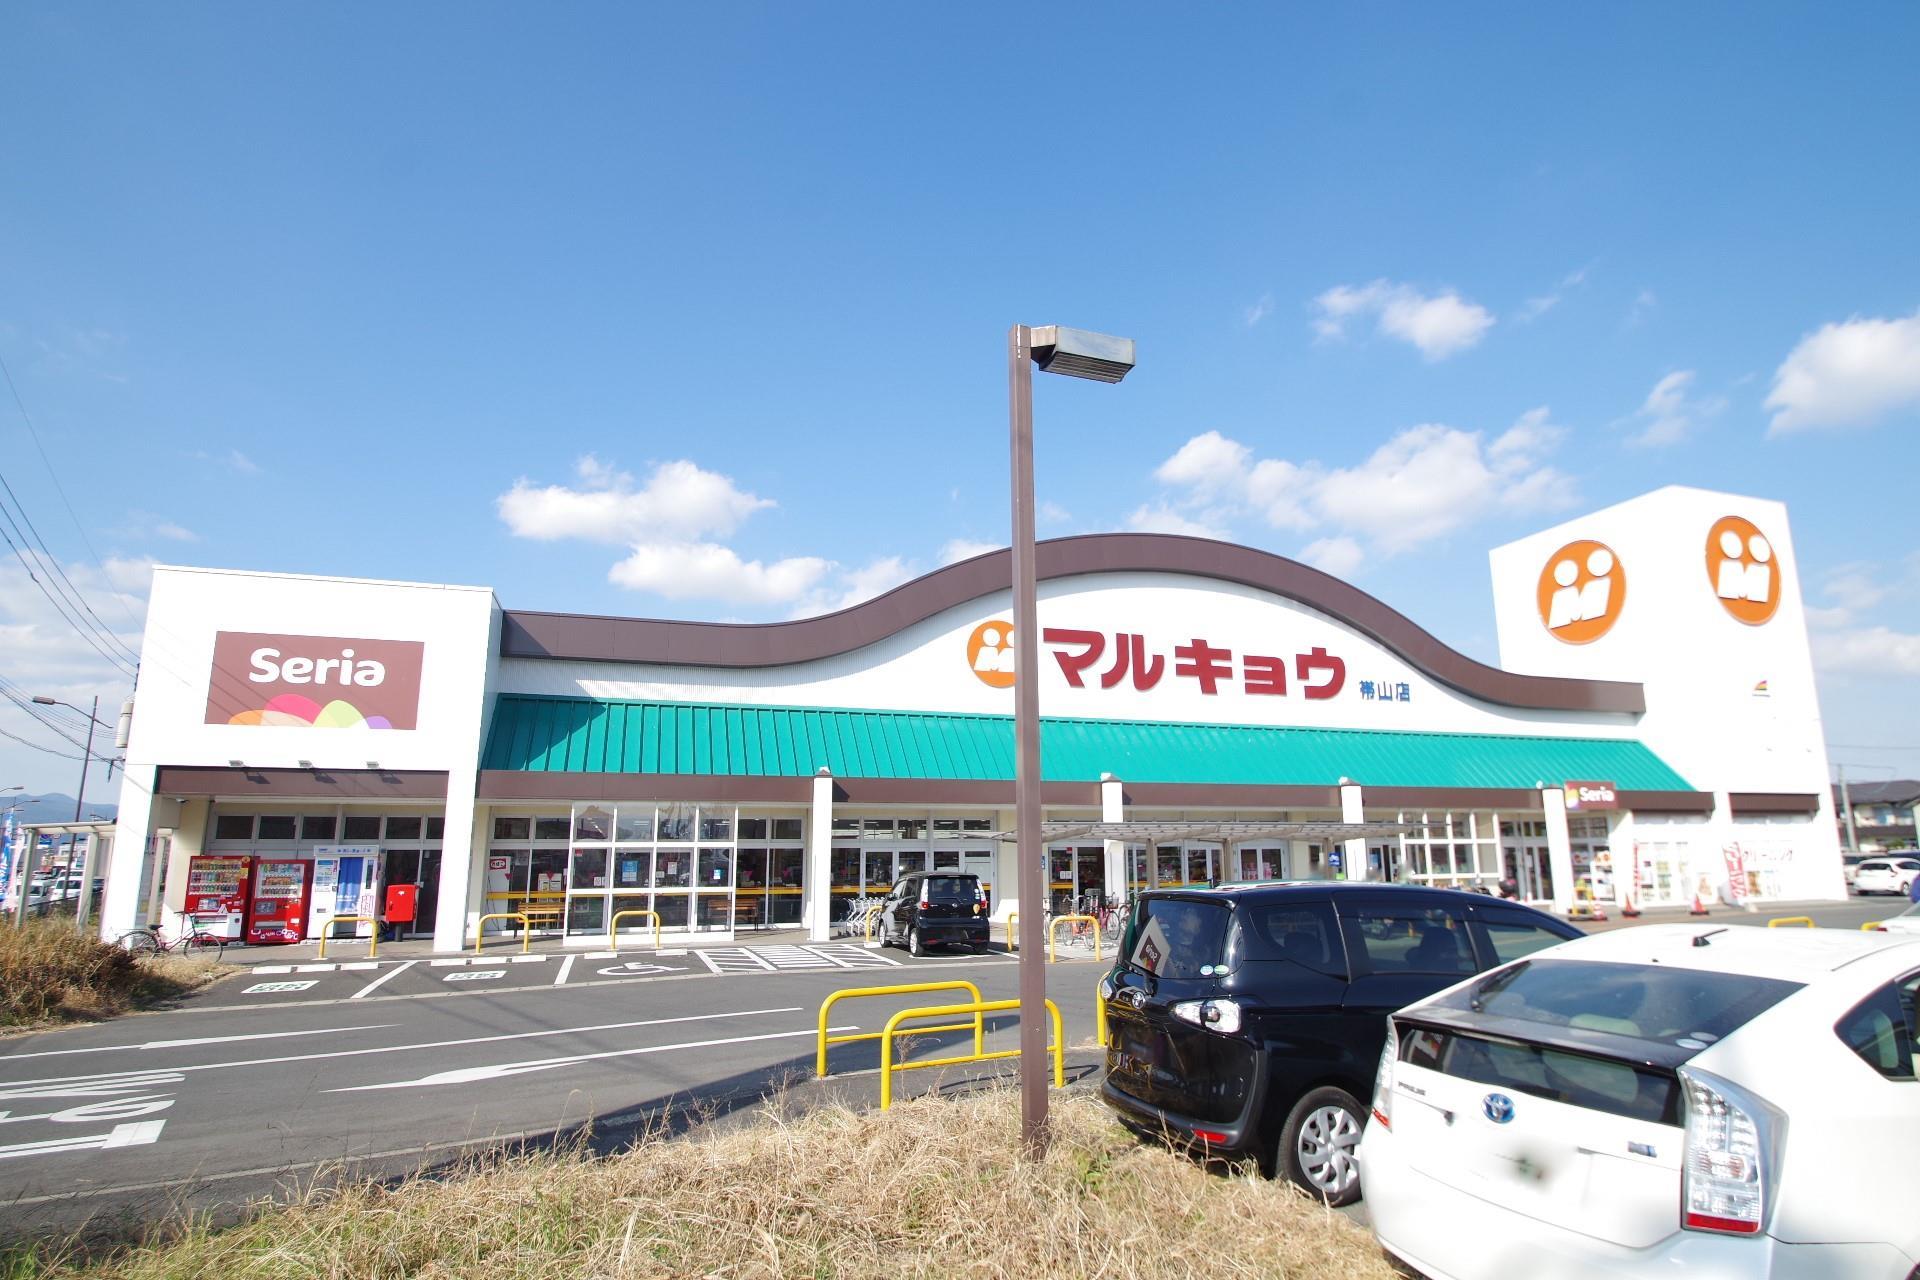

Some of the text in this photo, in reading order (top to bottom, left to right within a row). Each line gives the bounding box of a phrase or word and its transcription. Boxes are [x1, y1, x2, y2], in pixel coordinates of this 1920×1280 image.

[249, 647, 386, 687] Seria
[1044, 628, 1410, 702] マルキョウ 帯山店
[1579, 785, 1616, 802] Seria
